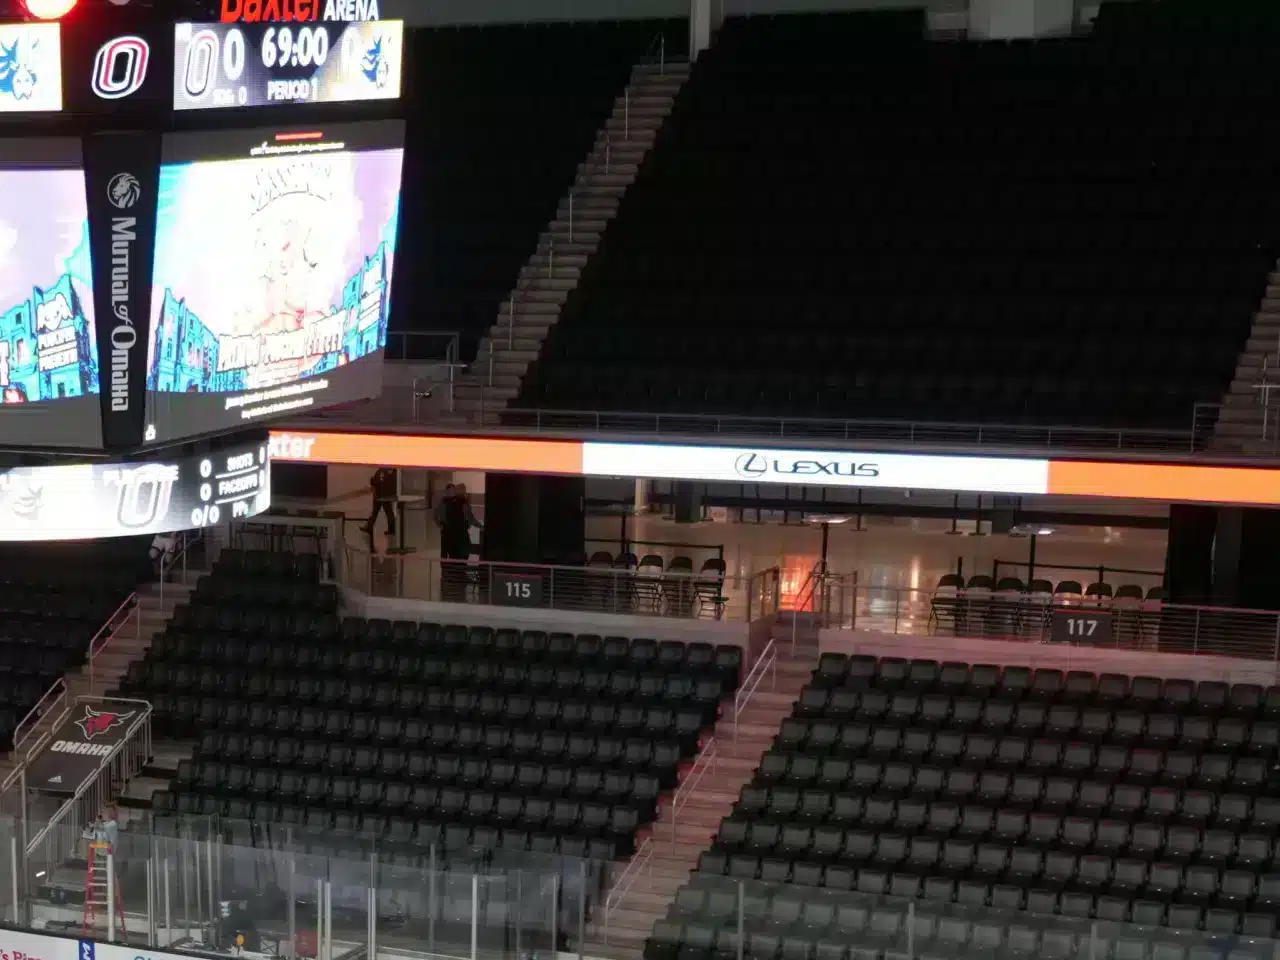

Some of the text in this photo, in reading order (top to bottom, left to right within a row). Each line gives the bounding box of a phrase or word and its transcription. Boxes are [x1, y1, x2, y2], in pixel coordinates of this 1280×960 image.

[323, 0, 380, 21] ARENA
[262, 27, 329, 67] 69:00
[267, 80, 310, 101] PERIOD
[113, 304, 133, 326] of
[268, 434, 316, 459] xter
[227, 453, 254, 472] SHOTS
[774, 460, 880, 477] LEXUS
[505, 582, 531, 598] 115
[1067, 618, 1098, 636] 117
[51, 740, 115, 757] OMAHA
